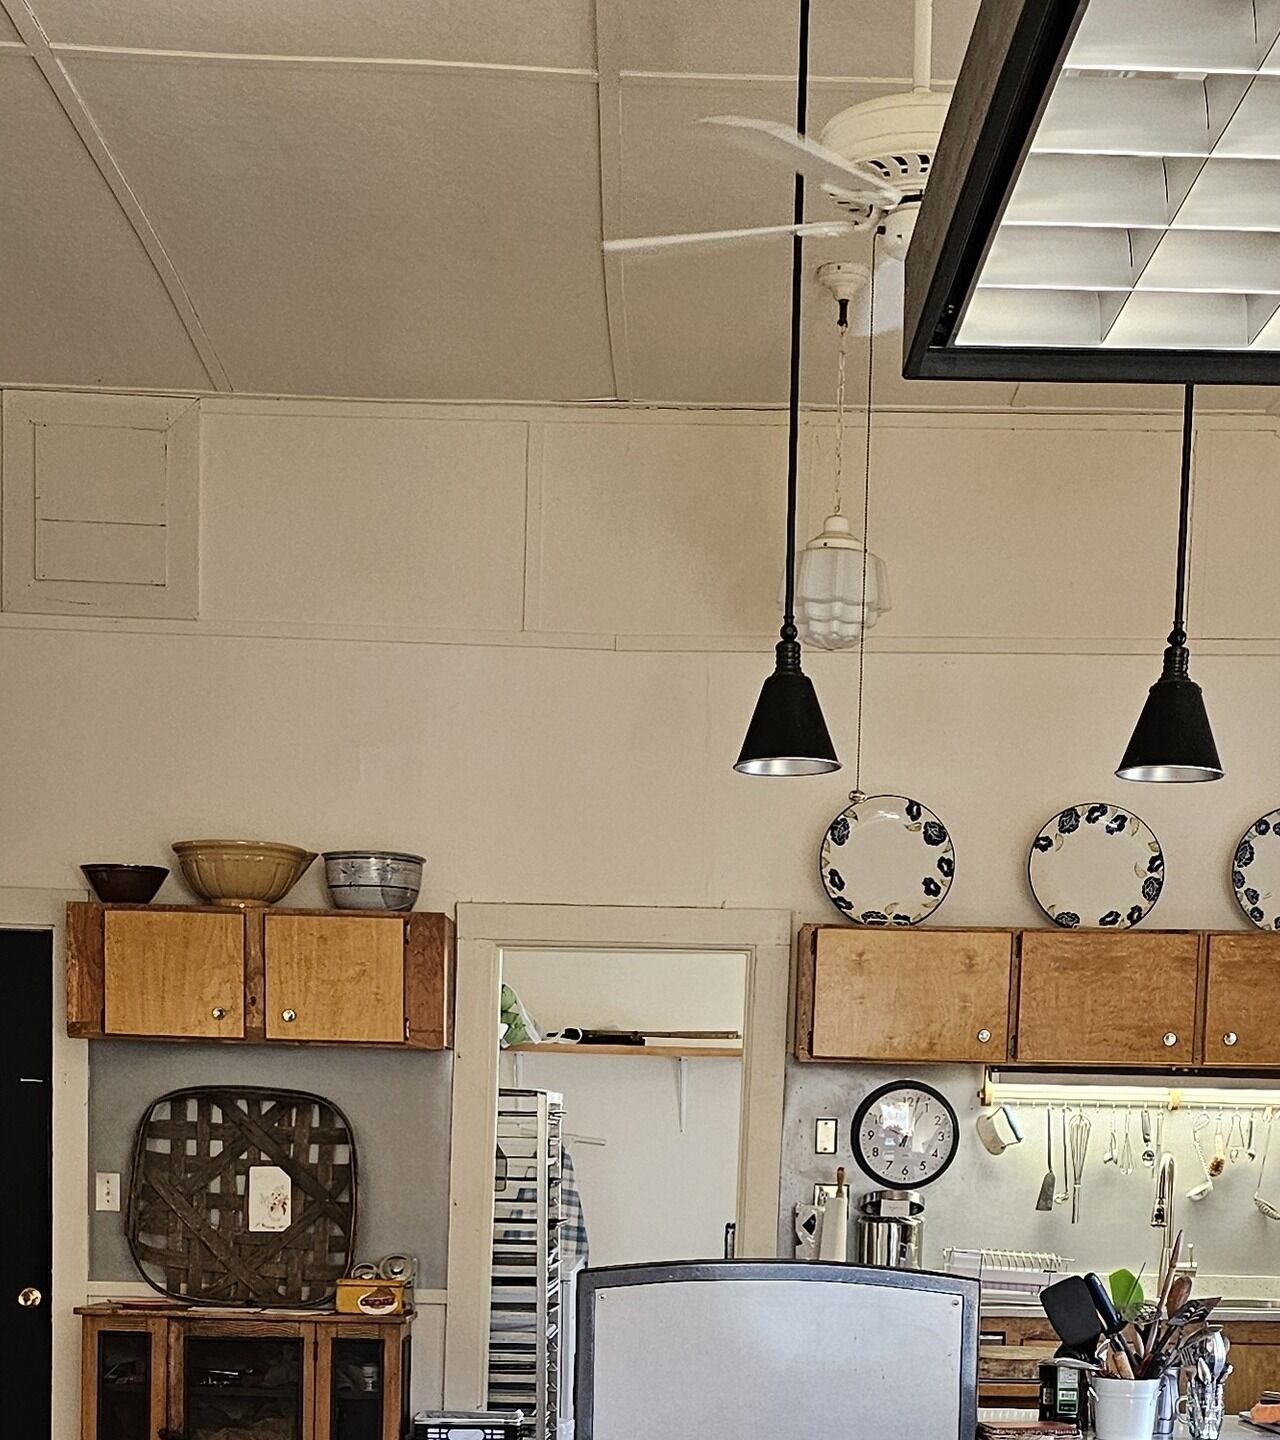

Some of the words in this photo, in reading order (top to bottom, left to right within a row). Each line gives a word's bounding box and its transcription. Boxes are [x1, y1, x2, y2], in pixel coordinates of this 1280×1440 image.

[902, 1096, 914, 1107] 12
[934, 1115, 941, 1126] 2
[867, 1130, 875, 1140] 9
[937, 1131, 945, 1141] 3
[872, 1147, 879, 1157] 8
[931, 1148, 938, 1158] 4
[886, 1160, 893, 1170] 7
[901, 1165, 909, 1175] 6
[919, 1160, 927, 1171] 5
